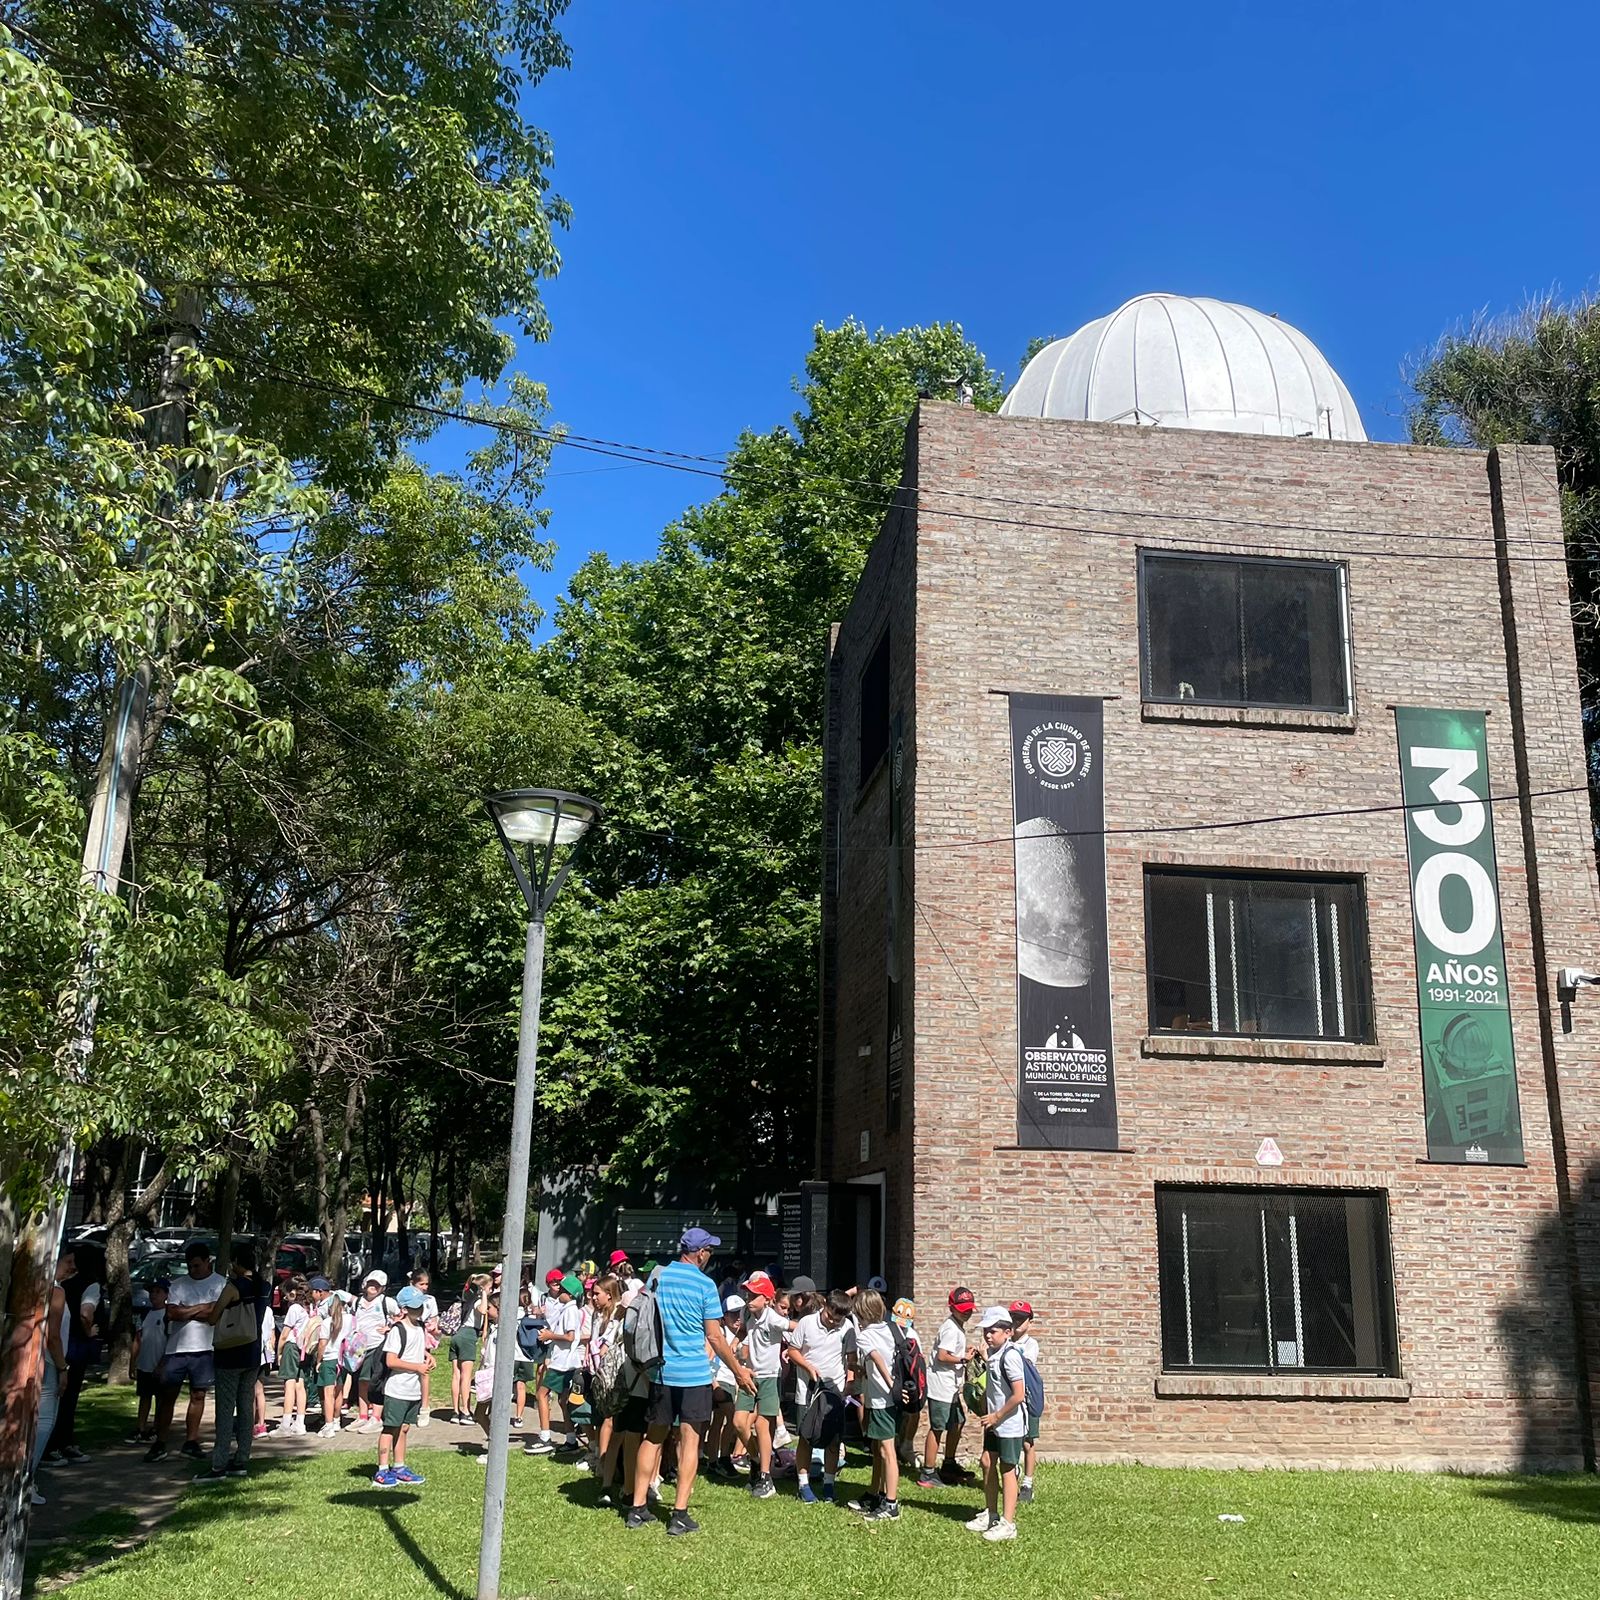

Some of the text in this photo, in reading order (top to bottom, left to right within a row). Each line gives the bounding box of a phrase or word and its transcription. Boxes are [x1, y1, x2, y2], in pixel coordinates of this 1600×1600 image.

[1022, 722, 1091, 778] GOBIERNO DE LA CIUDAD DE FUNES
[1040, 780, 1059, 789] DESDE
[1410, 746, 1496, 956] 30
[1426, 959, 1499, 986] AÑOS
[1428, 988, 1499, 1004] 1991-2021
[1025, 1051, 1106, 1063] OBSERVATORIO
[1025, 1062, 1107, 1074] ASTRONÓMICO
